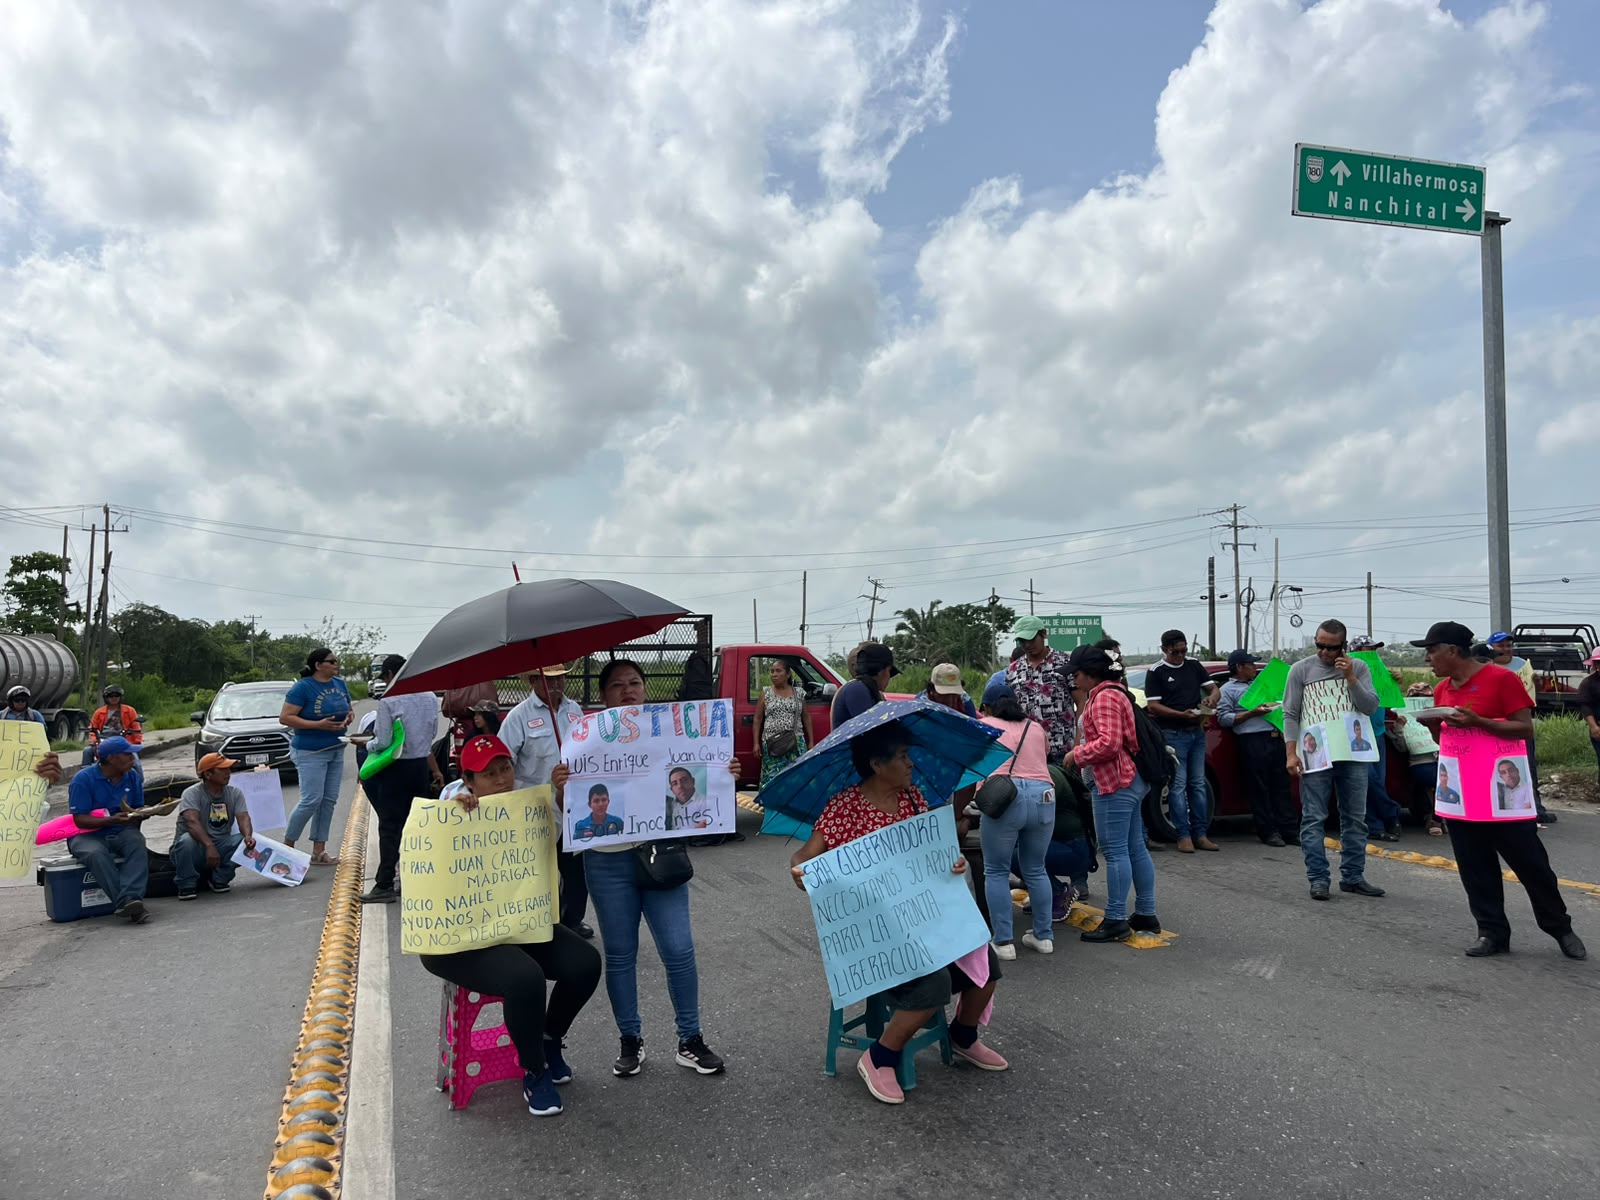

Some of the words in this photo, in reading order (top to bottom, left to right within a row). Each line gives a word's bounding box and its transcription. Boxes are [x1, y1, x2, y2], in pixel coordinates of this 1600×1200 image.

[1361, 163, 1478, 195] Villahermosa
[1327, 190, 1447, 221] Nanchital
[567, 700, 730, 743] JUSTICIA
[603, 753, 649, 774] Enrique
[668, 747, 696, 766] Juan
[698, 745, 731, 762] Carlos
[418, 805, 510, 828] JUSTICIA
[524, 804, 549, 823] PARA
[625, 797, 724, 835] Inocntes!
[403, 835, 433, 852] LUIS
[452, 829, 518, 852] ENRIQUE
[524, 825, 551, 843] PRIMO
[836, 814, 942, 876] GOBERNADORA
[410, 861, 435, 875] PARA
[448, 854, 484, 875] JUAN
[491, 846, 537, 871] CARLOS
[466, 865, 540, 889] MADRIGAL
[816, 867, 903, 926] NECESITAMOS
[904, 860, 924, 886] SU
[925, 844, 959, 877] APOYO
[444, 889, 494, 912] NAHLE
[401, 910, 474, 931] AYUDANOS
[481, 907, 492, 924] A
[403, 933, 423, 949] NO
[428, 930, 462, 948] NOS
[468, 918, 512, 944] DEJES
[822, 923, 866, 961] PARA
[868, 913, 891, 943] LA
[891, 888, 942, 933] PRONTA
[833, 932, 935, 998] LIBERACIÓN
